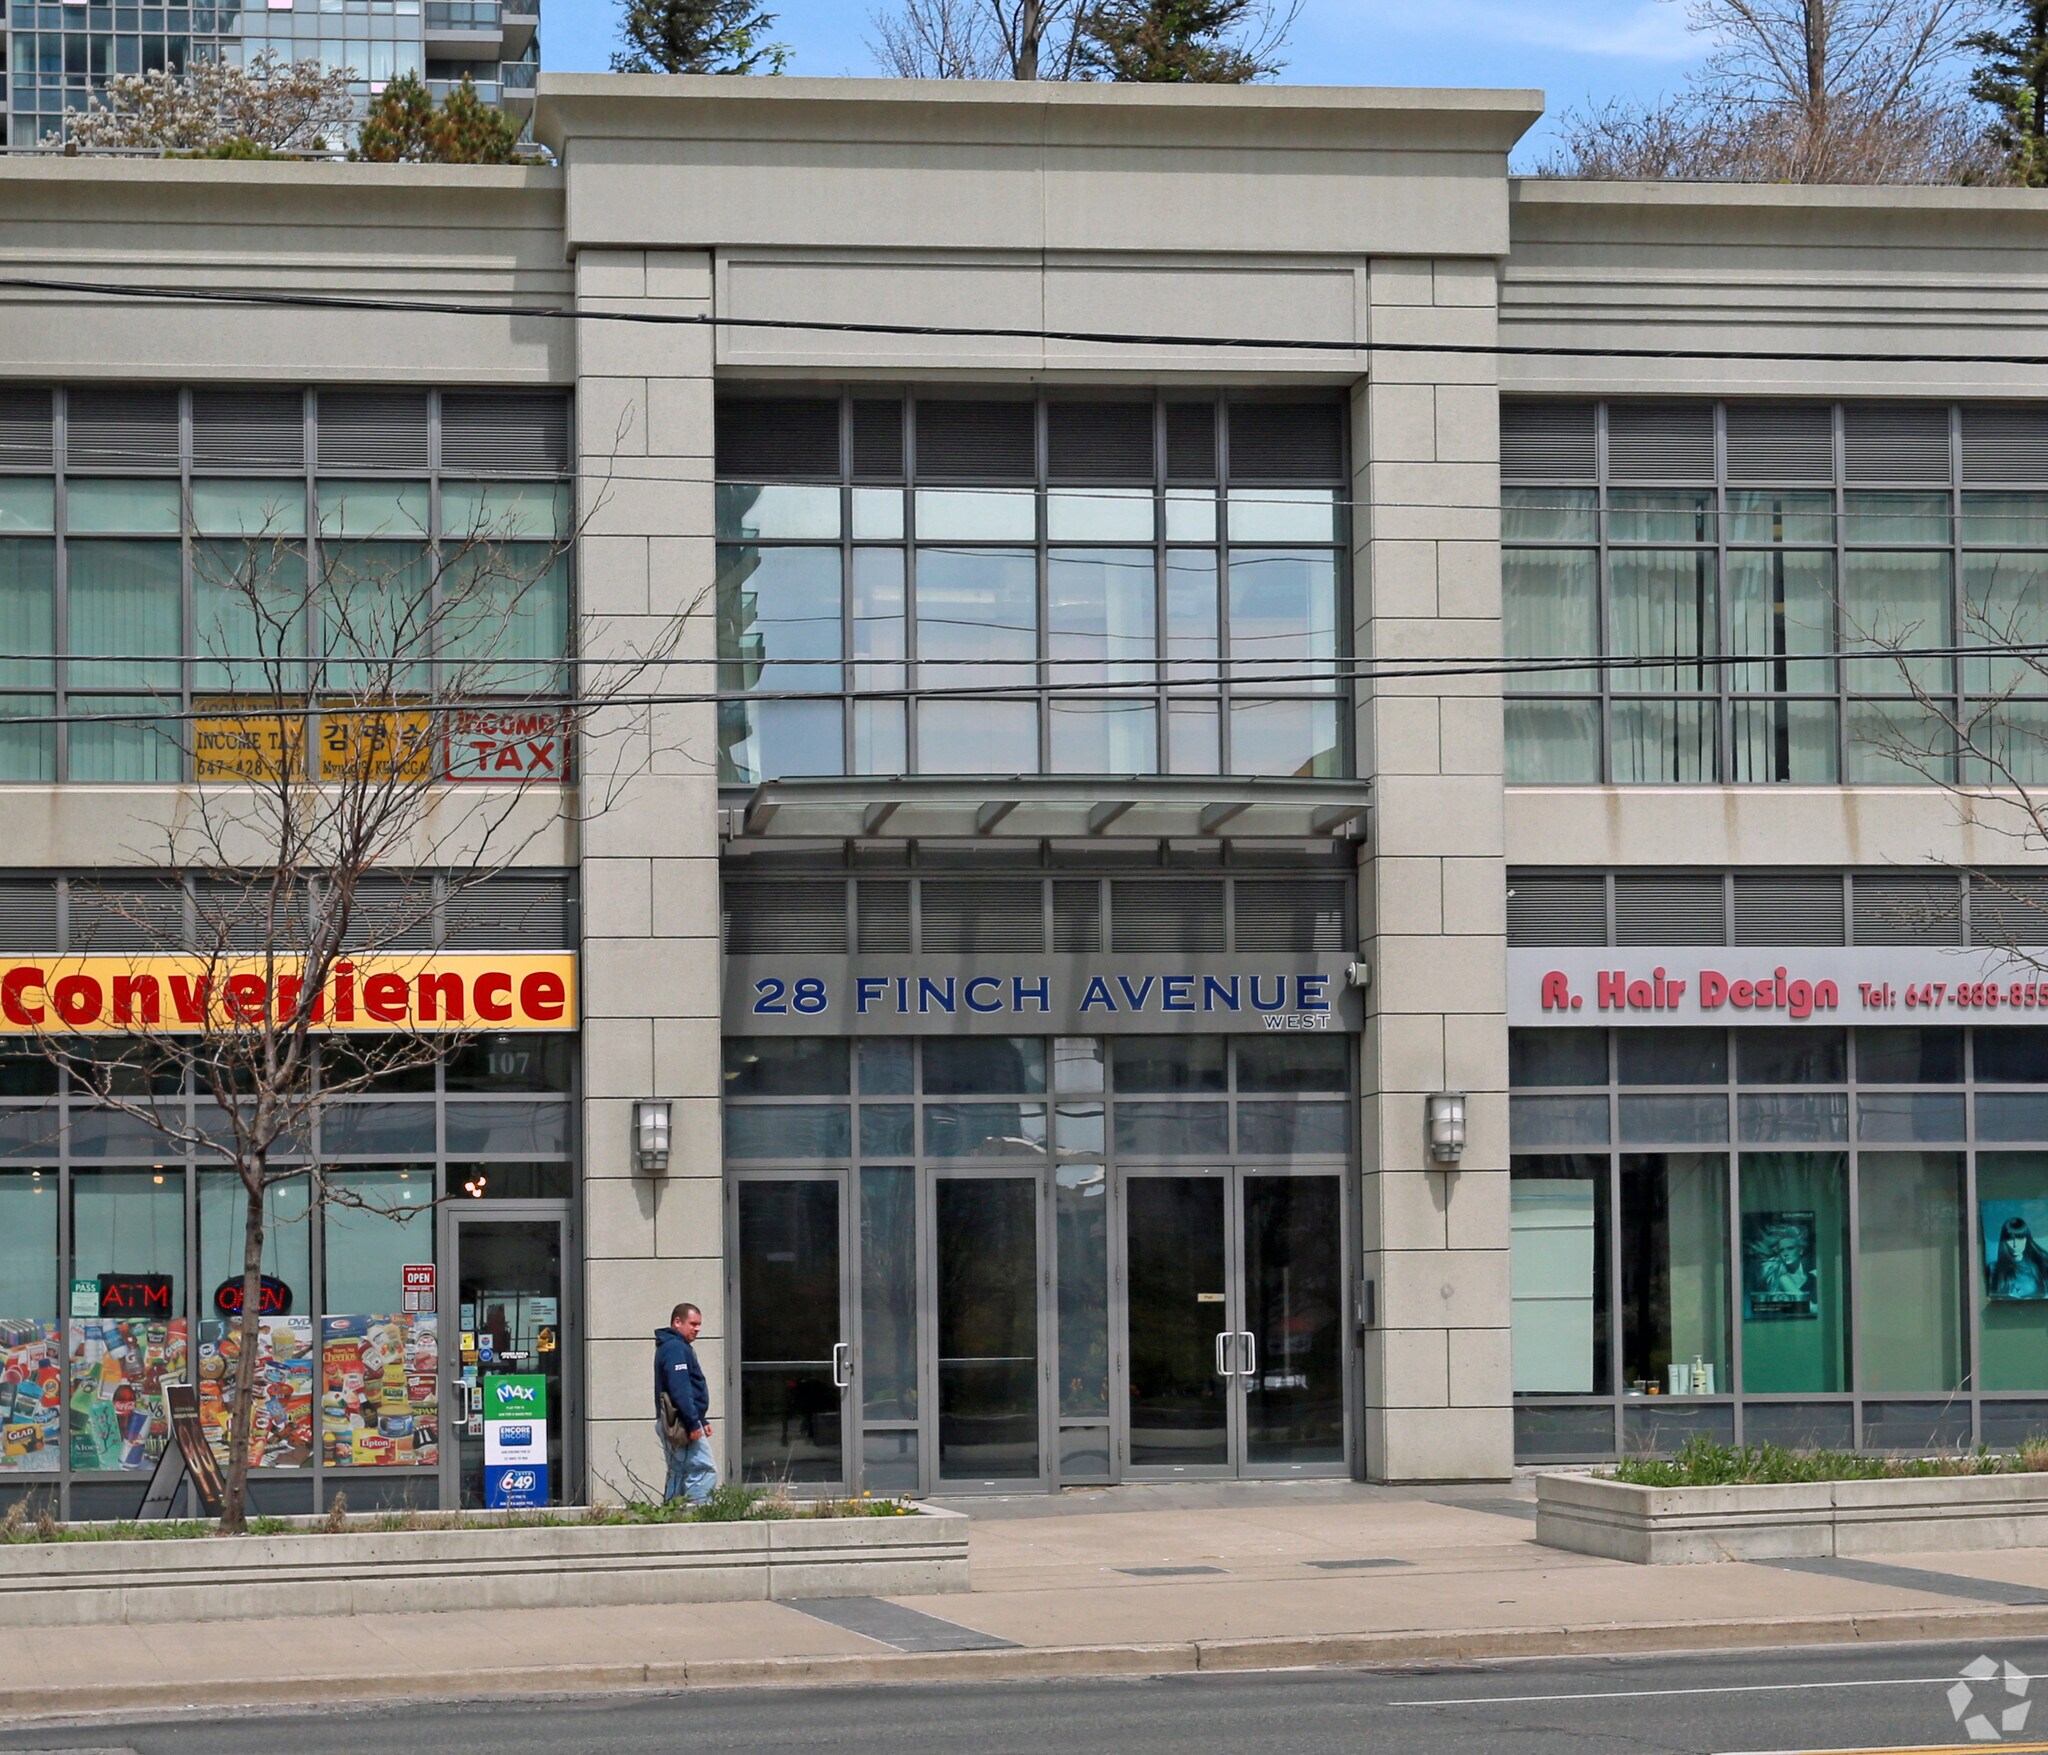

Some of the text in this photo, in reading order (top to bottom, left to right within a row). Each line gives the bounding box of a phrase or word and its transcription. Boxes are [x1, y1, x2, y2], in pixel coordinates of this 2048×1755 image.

[197, 732, 261, 750] INCOME
[469, 741, 555, 771] TAX
[1, 963, 566, 1025] Convenience
[753, 975, 1331, 1014] 28 FINCH AVENUE
[1541, 970, 1583, 1008] R.
[1597, 966, 1686, 1008] Hair
[1699, 966, 1839, 1018] Design
[1859, 982, 1897, 1007] Tel:
[1264, 1013, 1331, 1030] WEST
[489, 1052, 529, 1074] 107
[407, 1273, 430, 1283] OPEN
[75, 1284, 96, 1292] PASS
[102, 1285, 168, 1307] ATM
[323, 1351, 356, 1362] Cheerios
[497, 1385, 534, 1403] MAX
[149, 1401, 163, 1417] V8
[414, 1407, 437, 1415] SPAM
[8, 1428, 33, 1440] GLAD
[362, 1437, 389, 1447] Lipton
